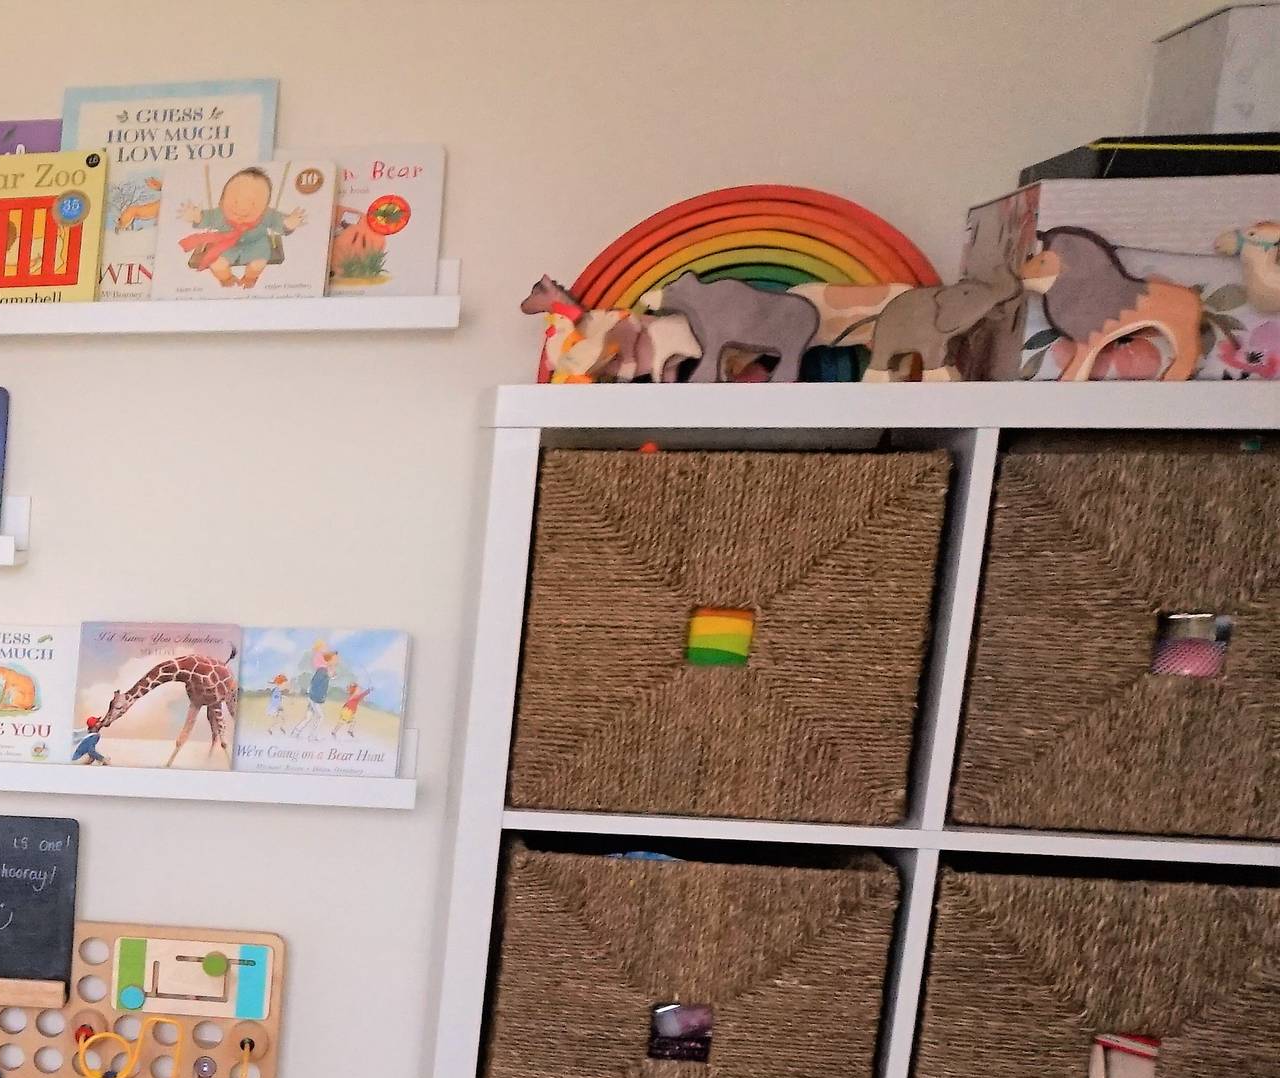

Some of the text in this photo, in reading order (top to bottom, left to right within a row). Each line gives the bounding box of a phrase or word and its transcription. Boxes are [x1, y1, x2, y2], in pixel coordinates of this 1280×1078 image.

[107, 125, 232, 144] HOW MUCH
[117, 146, 179, 163] LOVE
[186, 143, 236, 161] YOU
[34, 163, 87, 188] Zoo
[372, 160, 424, 180] Bear
[99, 263, 153, 285] WIN
[0, 648, 56, 661] MUCH
[11, 723, 52, 738] YOU
[237, 744, 264, 758] We're
[268, 746, 299, 761] Going
[328, 748, 354, 761] Bear
[356, 749, 385, 763] Hunt
[13, 836, 29, 850] is
[39, 834, 71, 852] one!
[1, 863, 57, 892] hooray!
